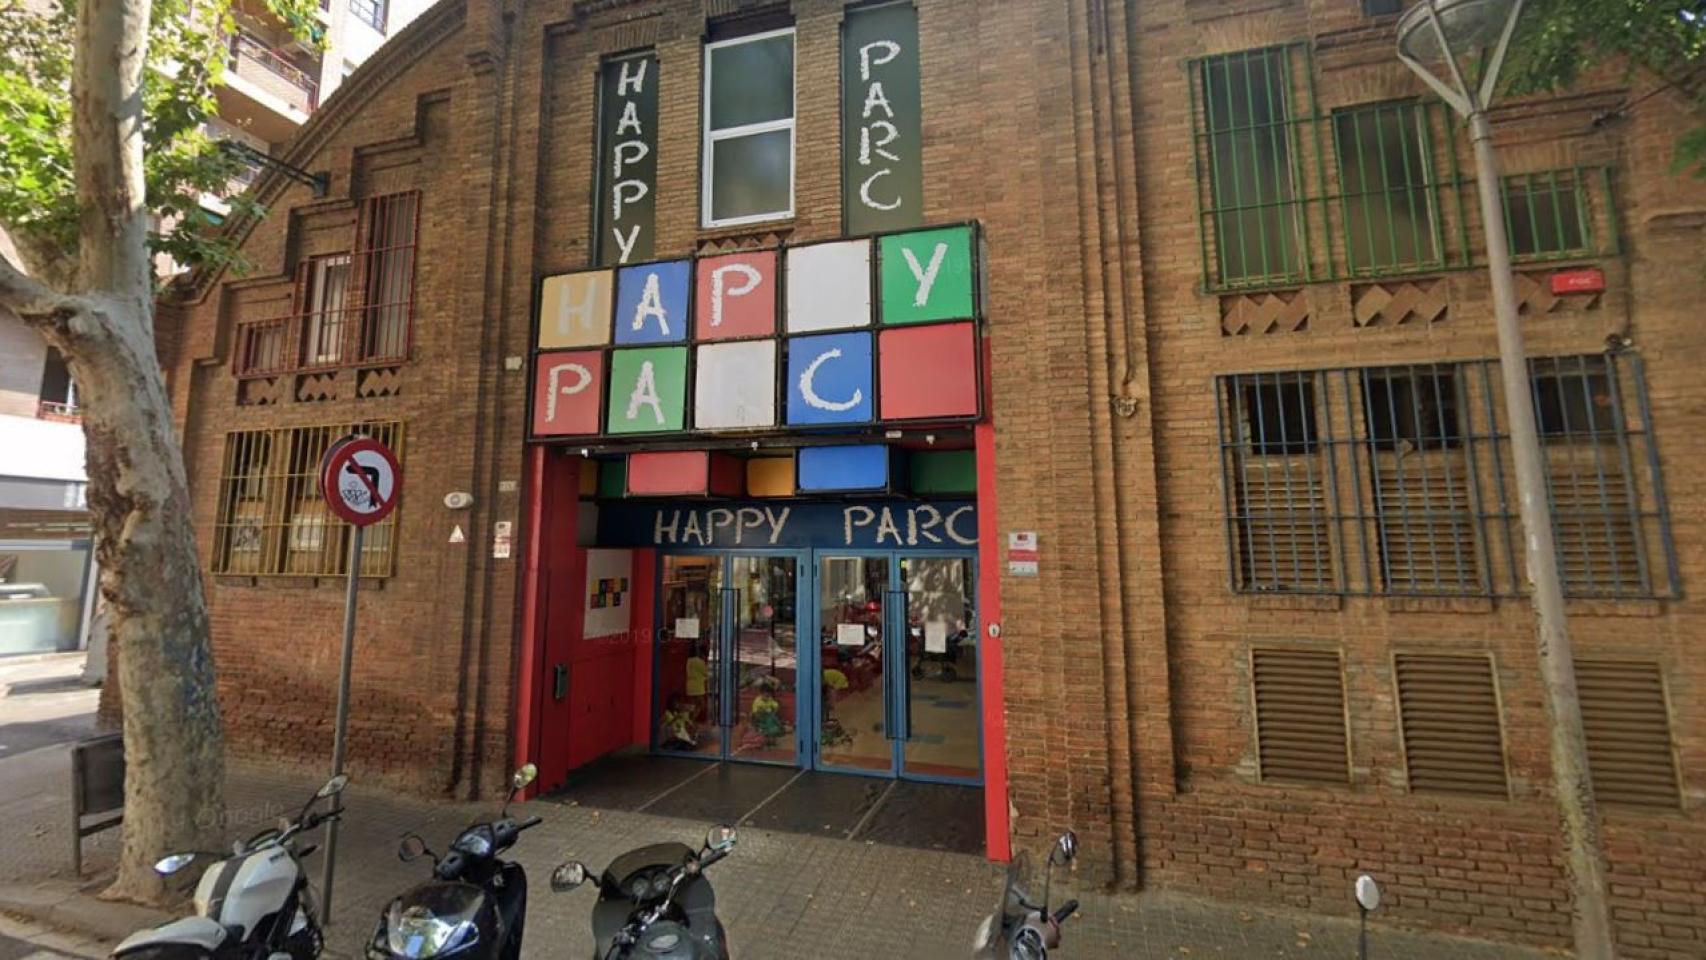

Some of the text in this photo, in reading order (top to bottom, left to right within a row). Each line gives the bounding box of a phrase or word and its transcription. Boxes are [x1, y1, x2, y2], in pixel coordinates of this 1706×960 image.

[613, 59, 648, 264] HAPPY
[860, 40, 901, 210] PARC
[654, 503, 978, 546] HAPPY PARC
